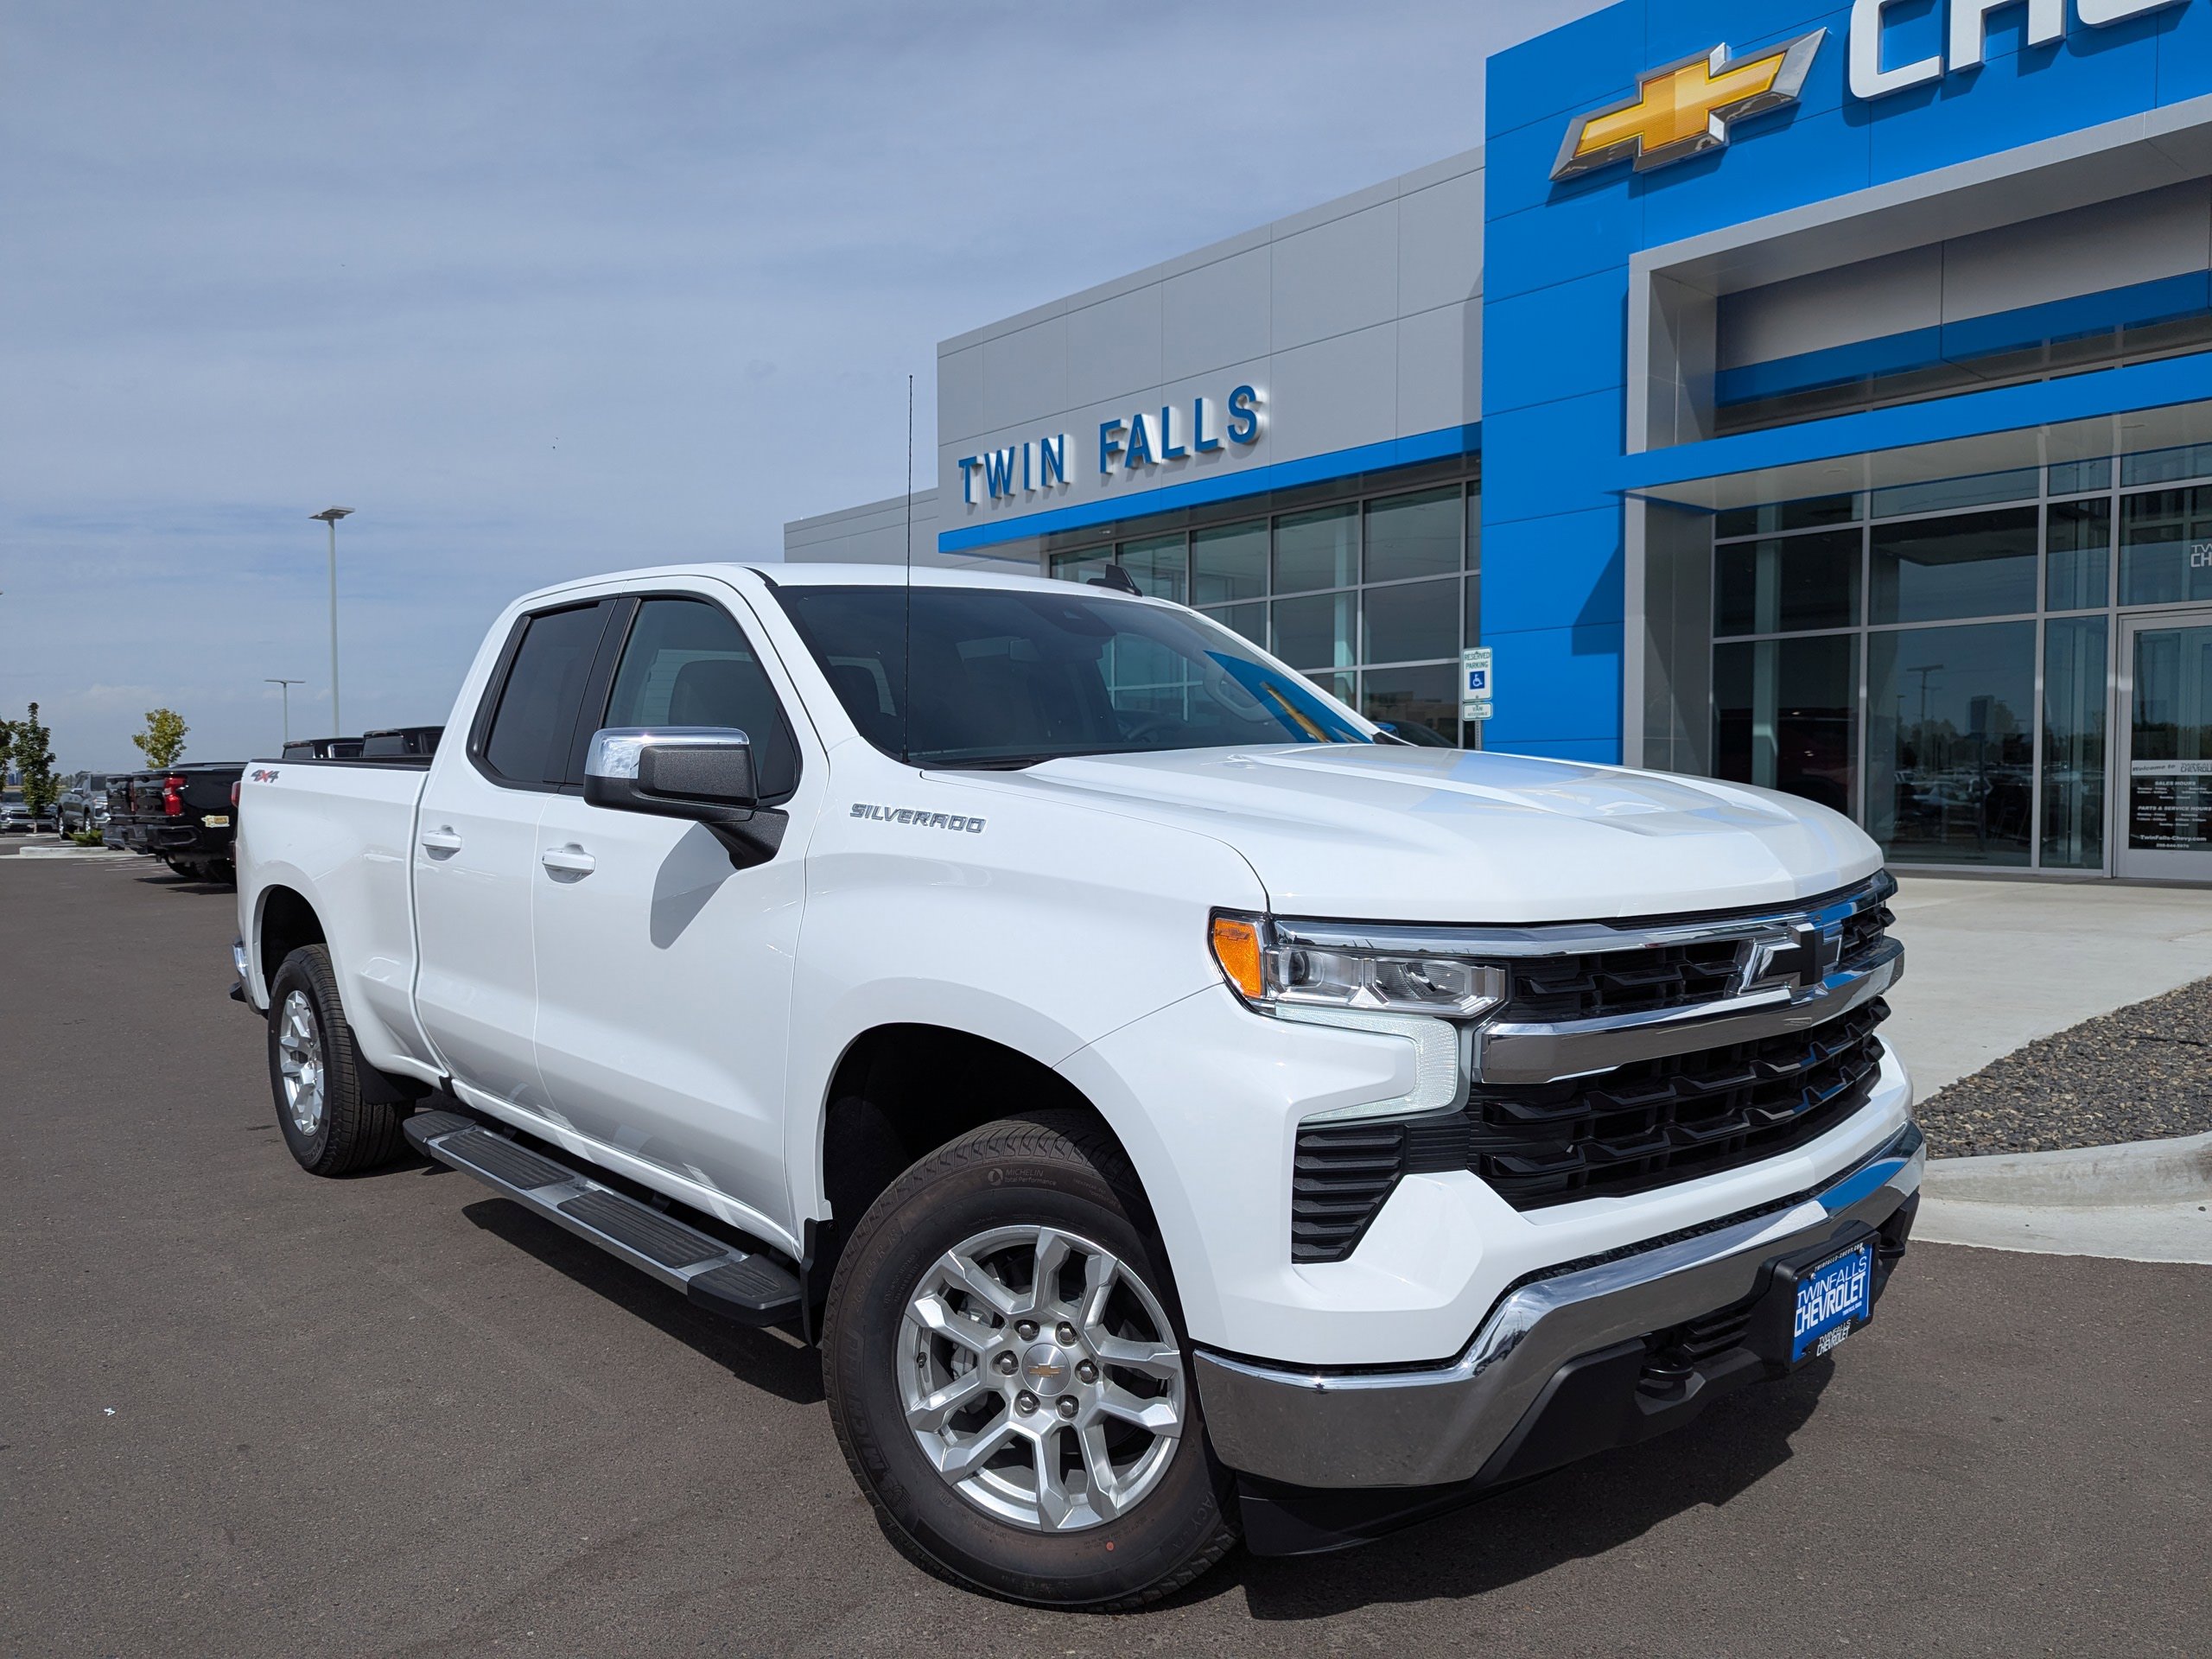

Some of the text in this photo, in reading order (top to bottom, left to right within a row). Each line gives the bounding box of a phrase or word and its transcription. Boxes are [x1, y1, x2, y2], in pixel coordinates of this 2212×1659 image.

[958, 385, 1262, 504] TWIN FALLS
[1464, 652, 1491, 661] RESERVED
[1465, 661, 1489, 670] PARKING
[849, 803, 987, 834] SILVERADO
[1797, 1255, 1867, 1308] TWINFALLS
[1794, 1271, 1866, 1338] CHEVROLET
[1816, 1327, 1850, 1357] CHEVROLET
